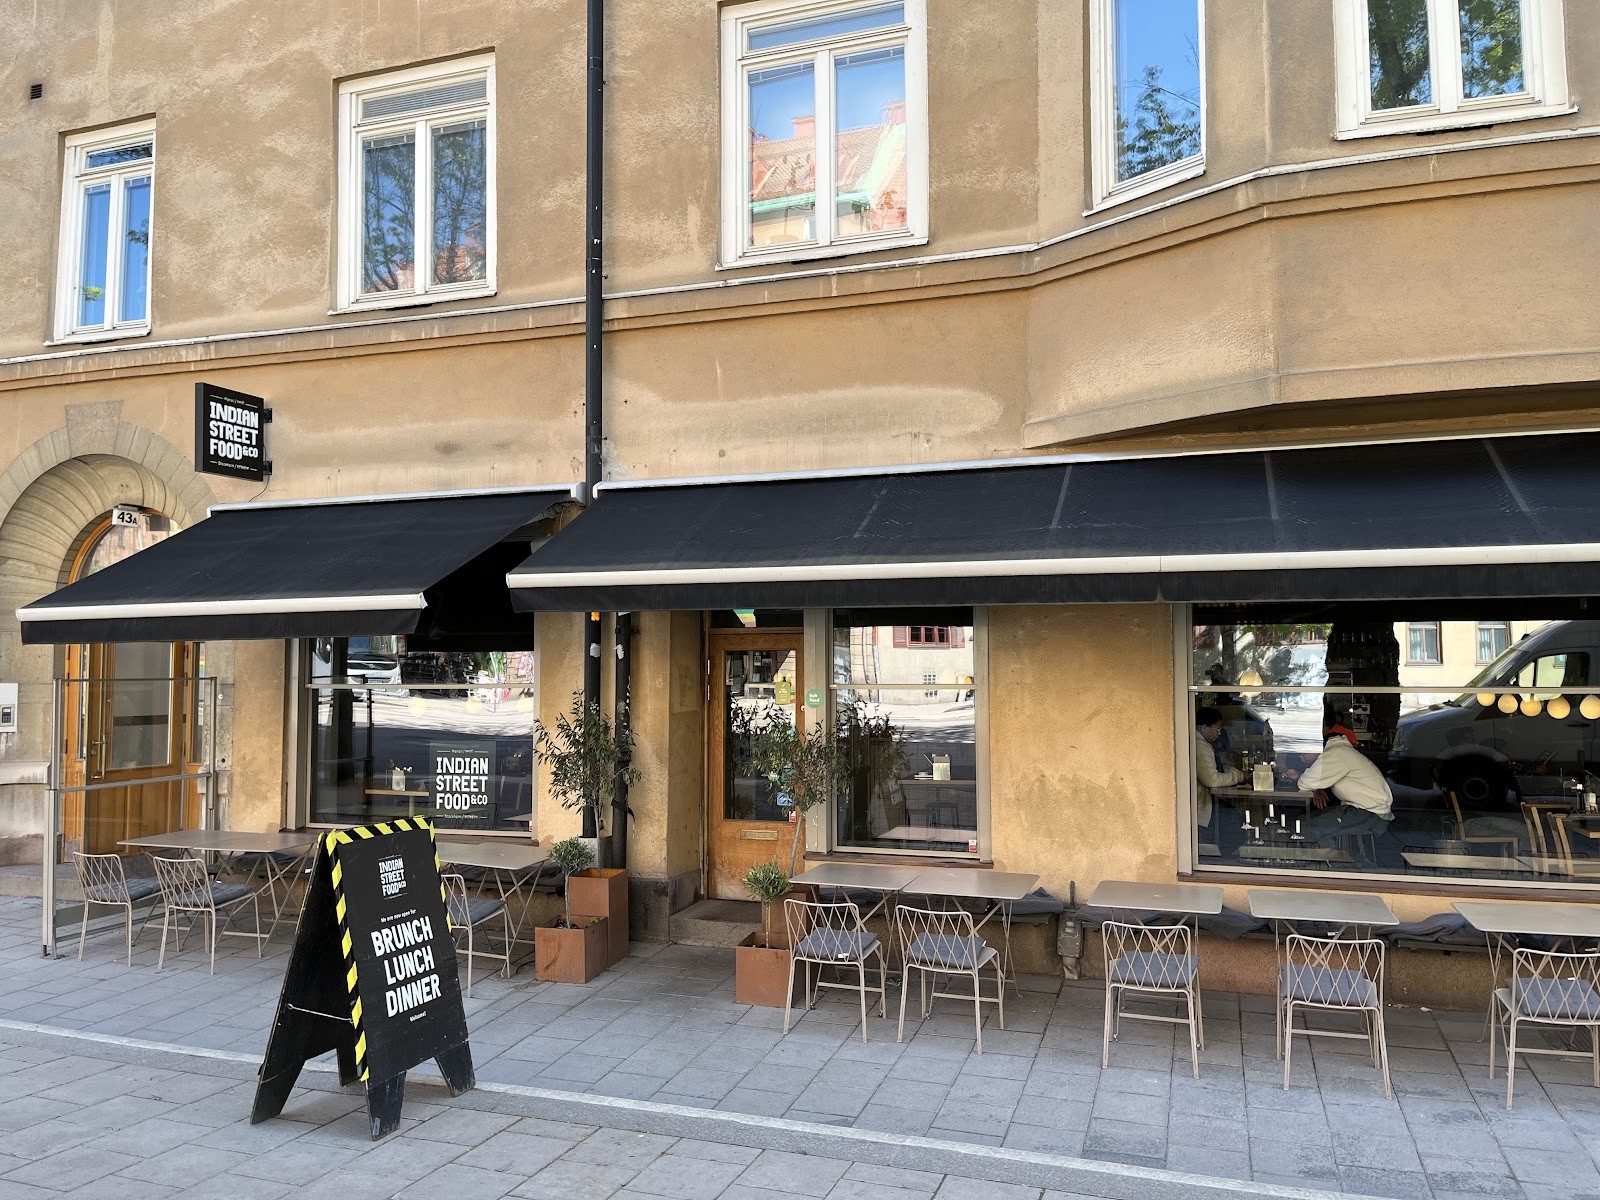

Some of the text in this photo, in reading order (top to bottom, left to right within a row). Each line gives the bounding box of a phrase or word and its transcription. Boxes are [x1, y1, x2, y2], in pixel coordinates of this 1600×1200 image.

[209, 401, 259, 429] INDIAN
[209, 420, 259, 446] STREET
[436, 757, 489, 774] INDIAN
[436, 775, 489, 792] STREET
[379, 858, 404, 874] INDIAN
[380, 869, 405, 885] STREET
[370, 915, 434, 957] BRUNCH
[383, 945, 435, 986] LUNCH
[385, 973, 442, 1018] DINNER
